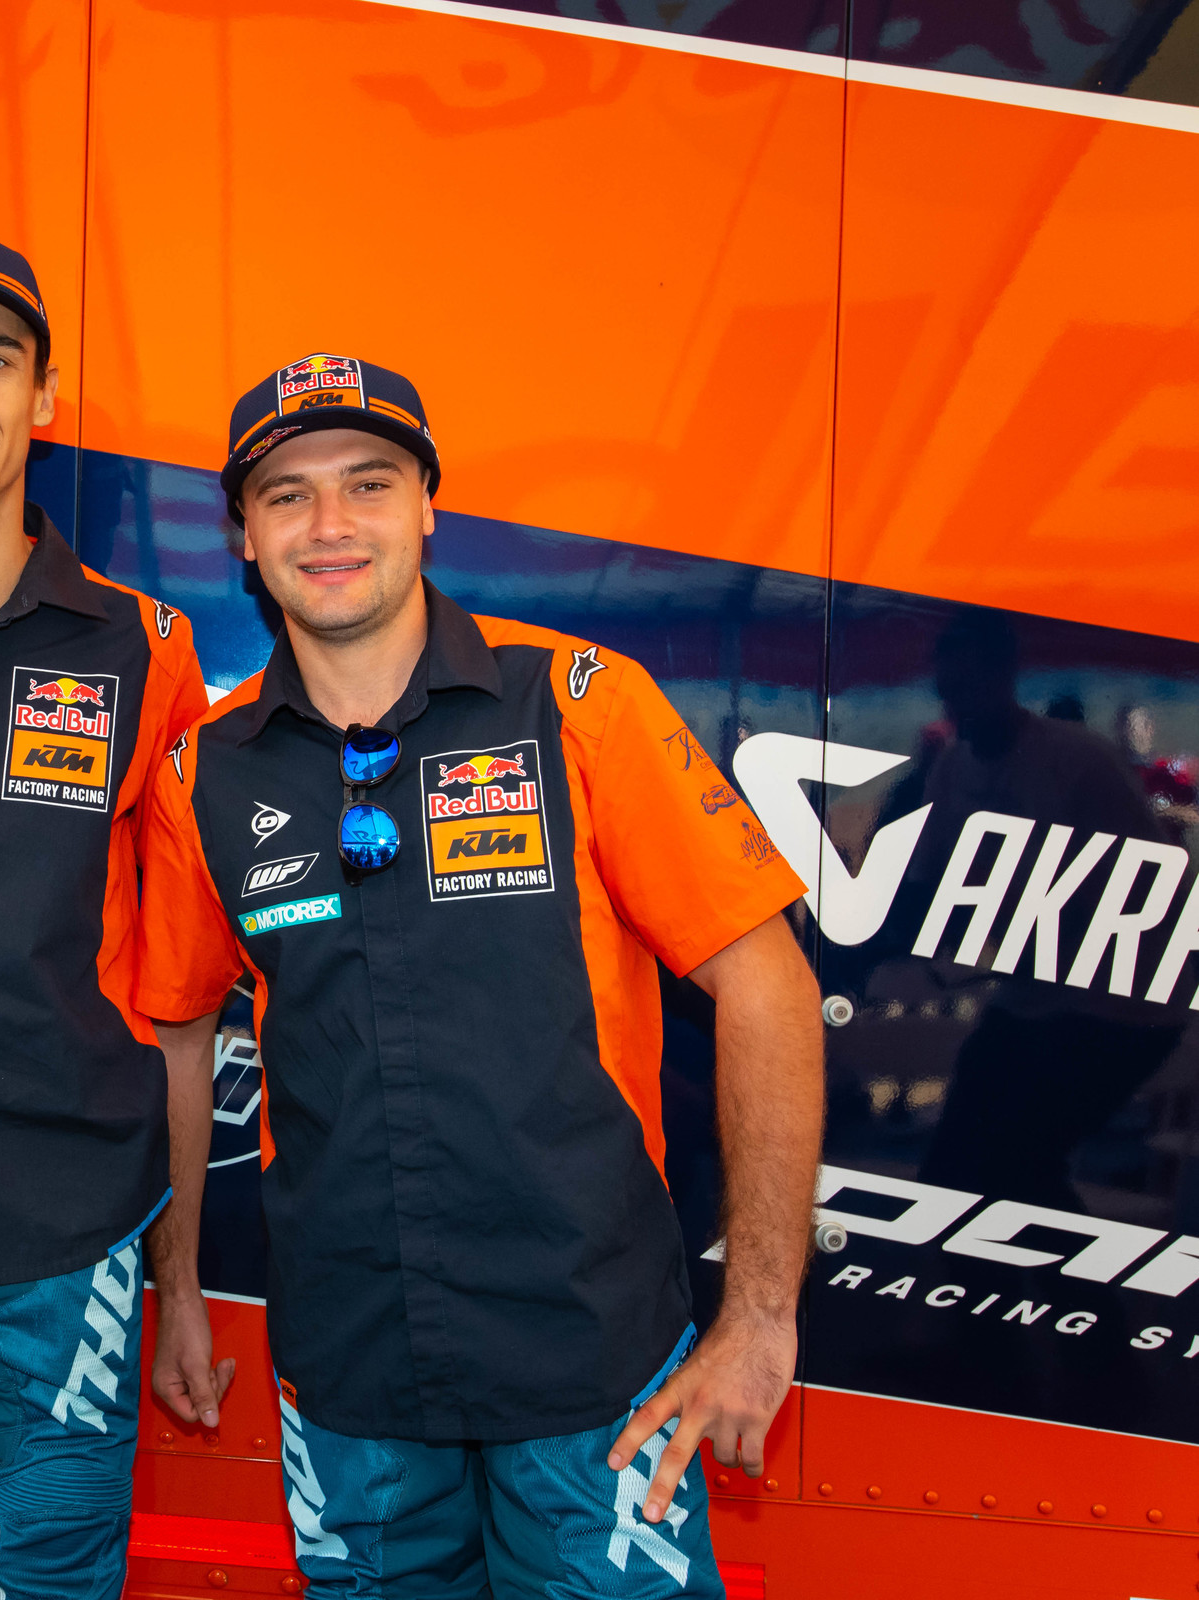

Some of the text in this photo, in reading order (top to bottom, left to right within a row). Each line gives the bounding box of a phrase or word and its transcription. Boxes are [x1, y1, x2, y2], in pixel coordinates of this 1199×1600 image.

[281, 372, 359, 398] Red Bull
[299, 392, 343, 409] KTM
[15, 704, 110, 738] Red Bull
[23, 744, 95, 774] KTM
[8, 780, 105, 804] FACTORY RACING
[428, 781, 538, 819] Red Bull
[447, 828, 527, 859] KTM
[249, 860, 304, 890] WP
[435, 869, 547, 893] FACTORY RACING
[828, 1264, 1099, 1336] RACING
